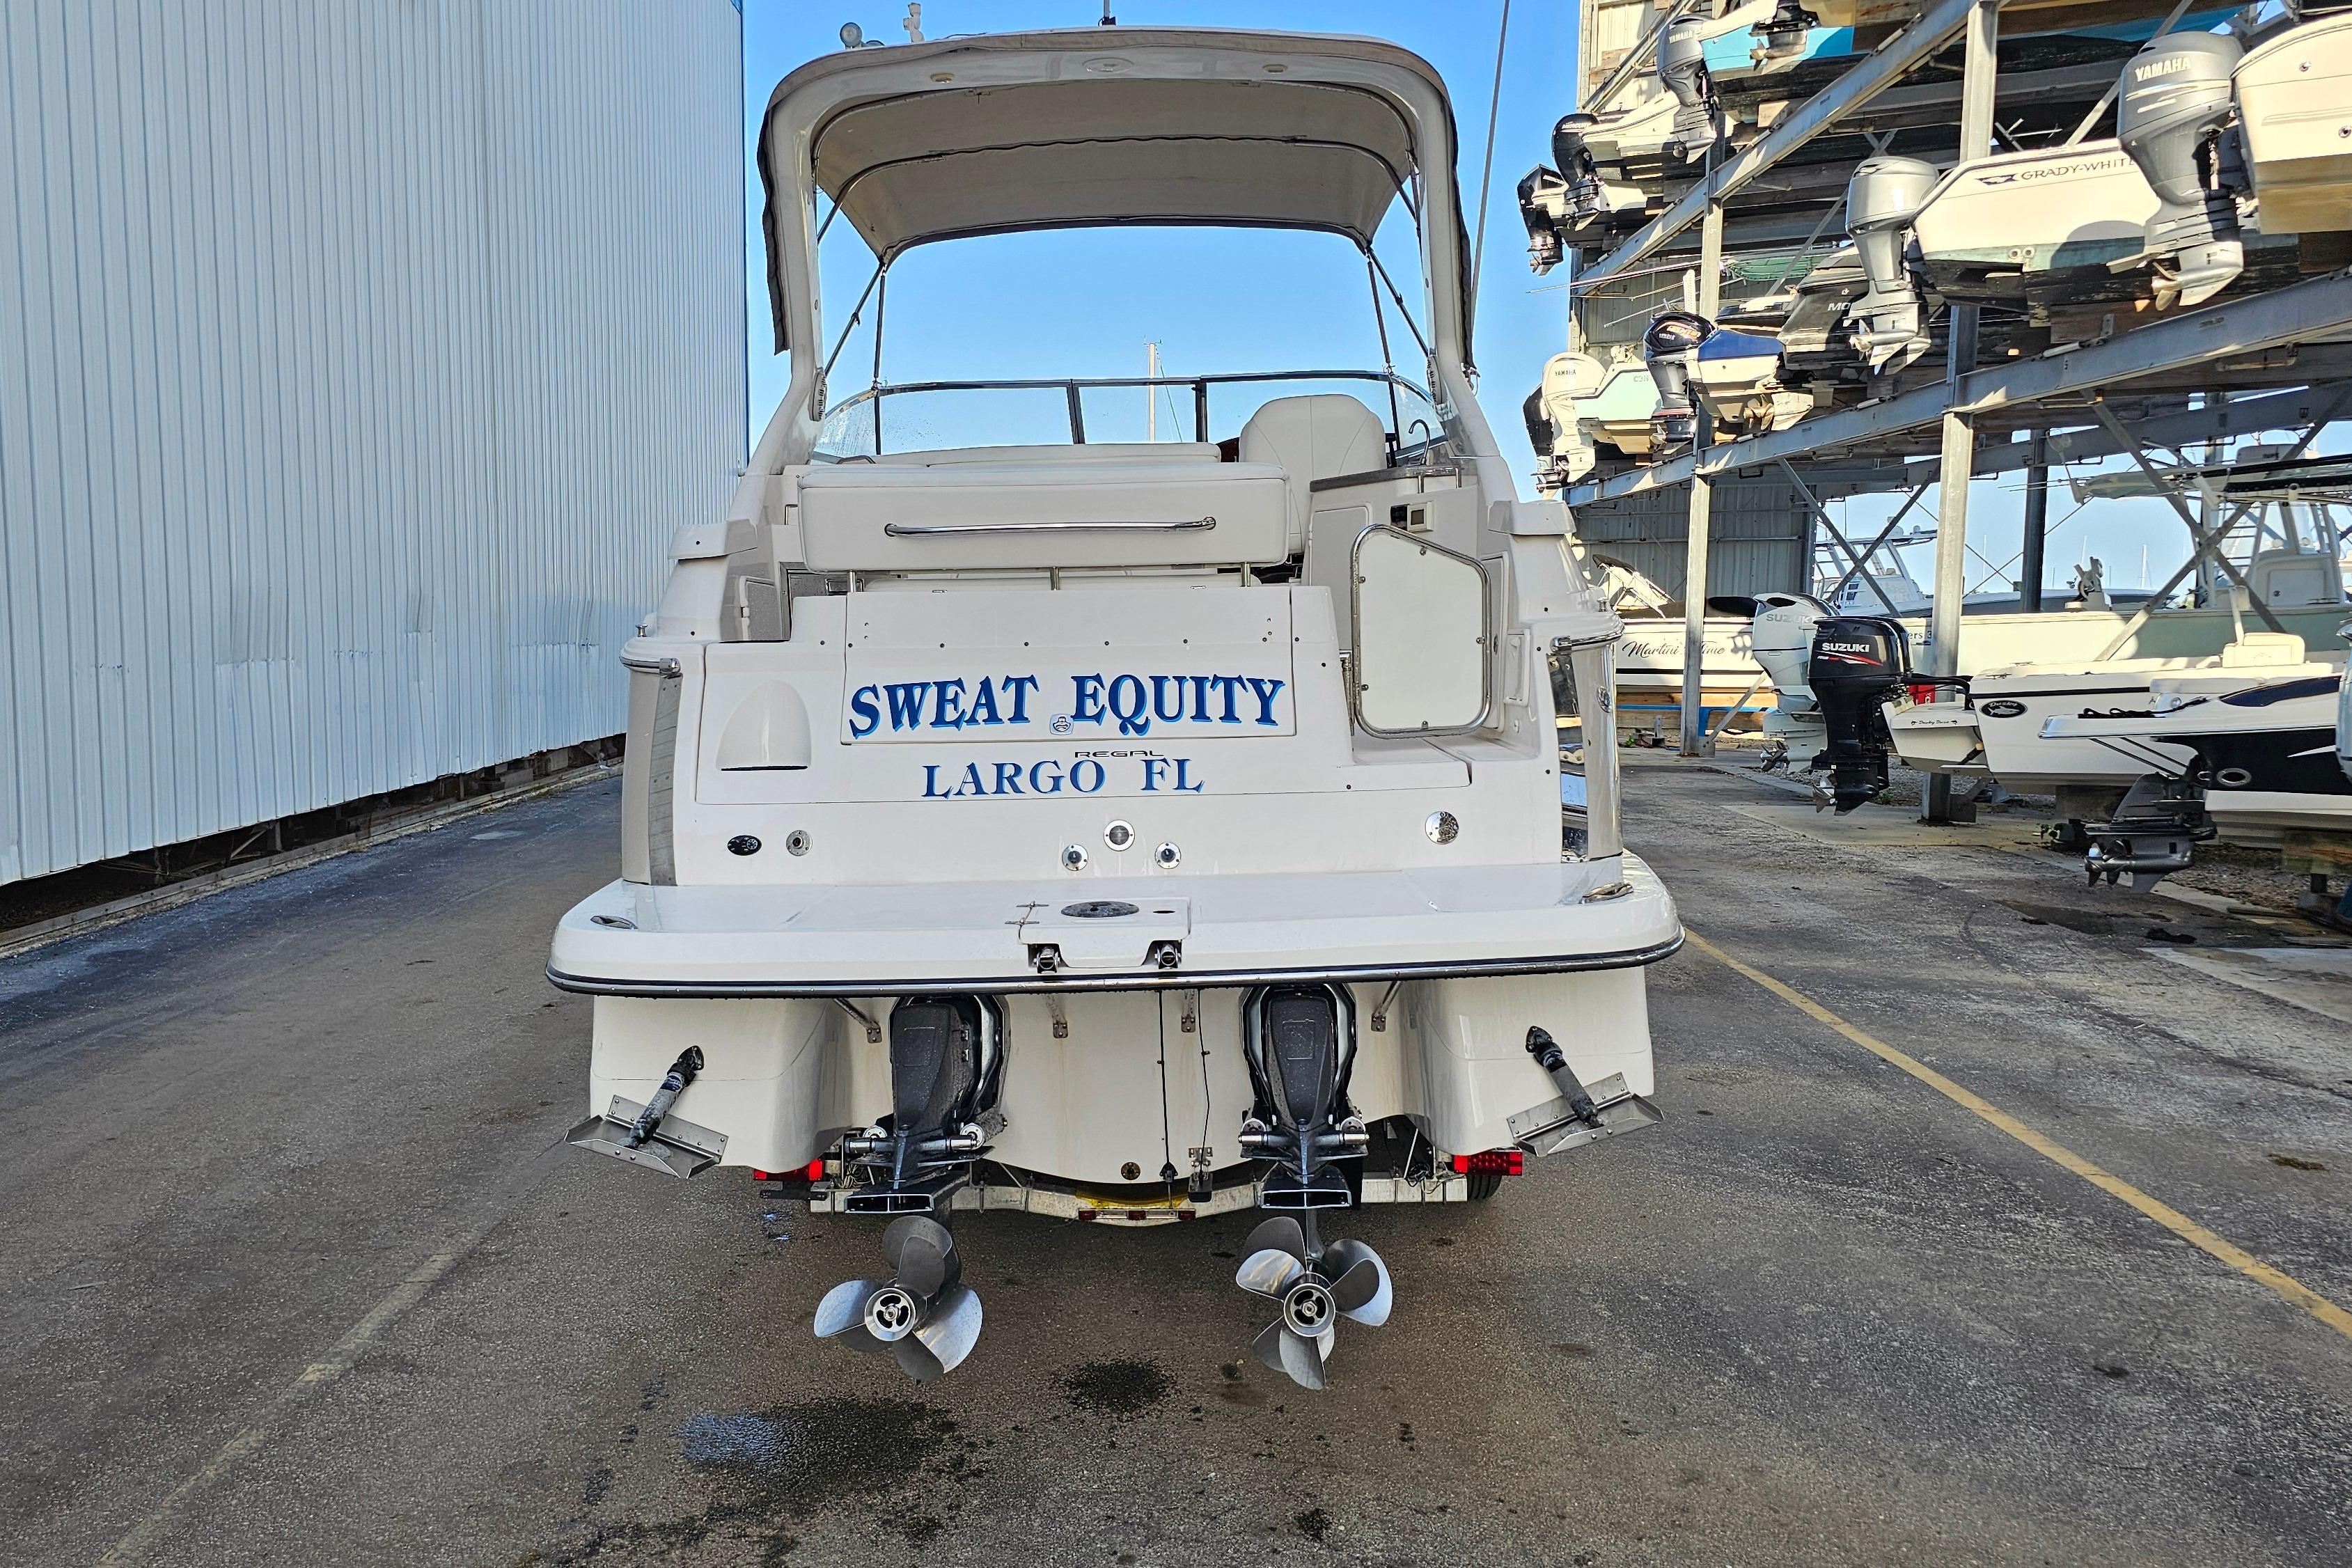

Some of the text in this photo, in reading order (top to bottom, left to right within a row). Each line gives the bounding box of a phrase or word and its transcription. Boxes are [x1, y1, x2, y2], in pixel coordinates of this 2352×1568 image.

[2135, 57, 2191, 81] YAMAHA
[1622, 641, 1679, 659] Martini
[1821, 642, 1869, 652] SUZUKI
[849, 673, 1286, 739] SWEAT EQUITY
[1074, 750, 1165, 758] REGAL
[921, 758, 1205, 799] LARGO FL
